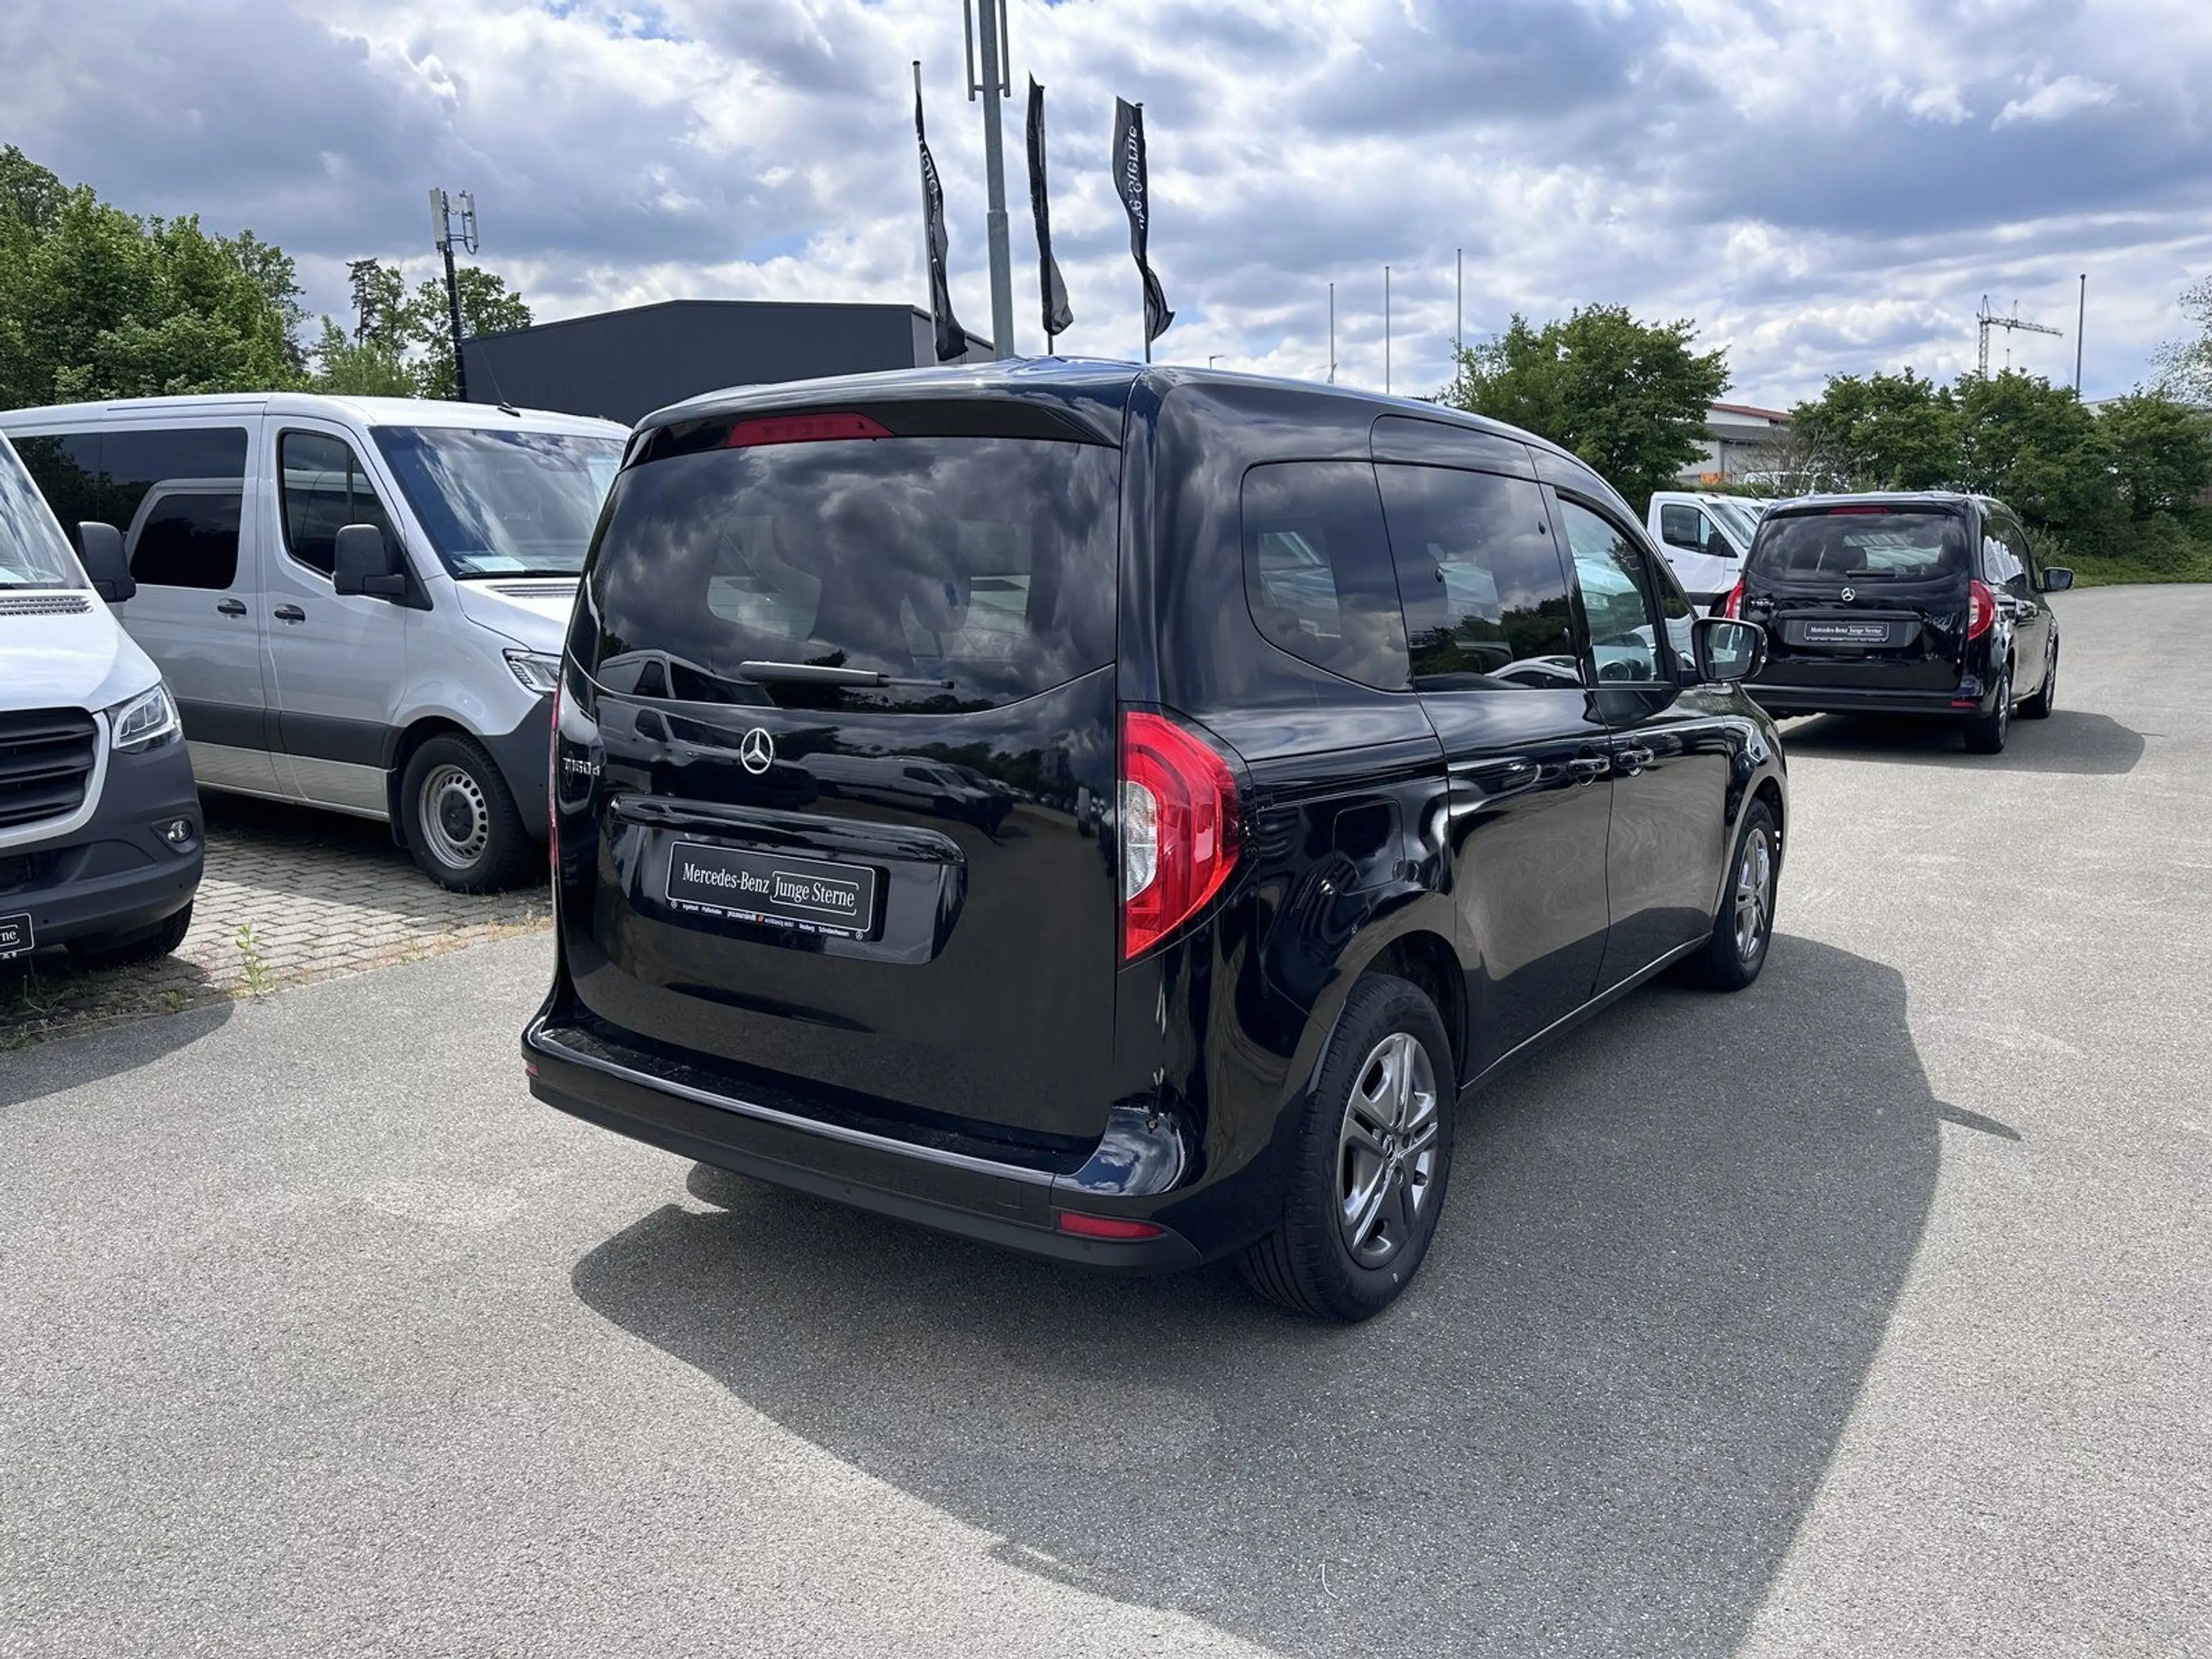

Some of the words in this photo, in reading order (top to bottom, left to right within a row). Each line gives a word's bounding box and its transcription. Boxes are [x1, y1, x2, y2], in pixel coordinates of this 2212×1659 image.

[682, 862, 770, 894] Mercedes-Benz
[774, 876, 810, 903] Junge
[811, 882, 855, 907] Sterne
